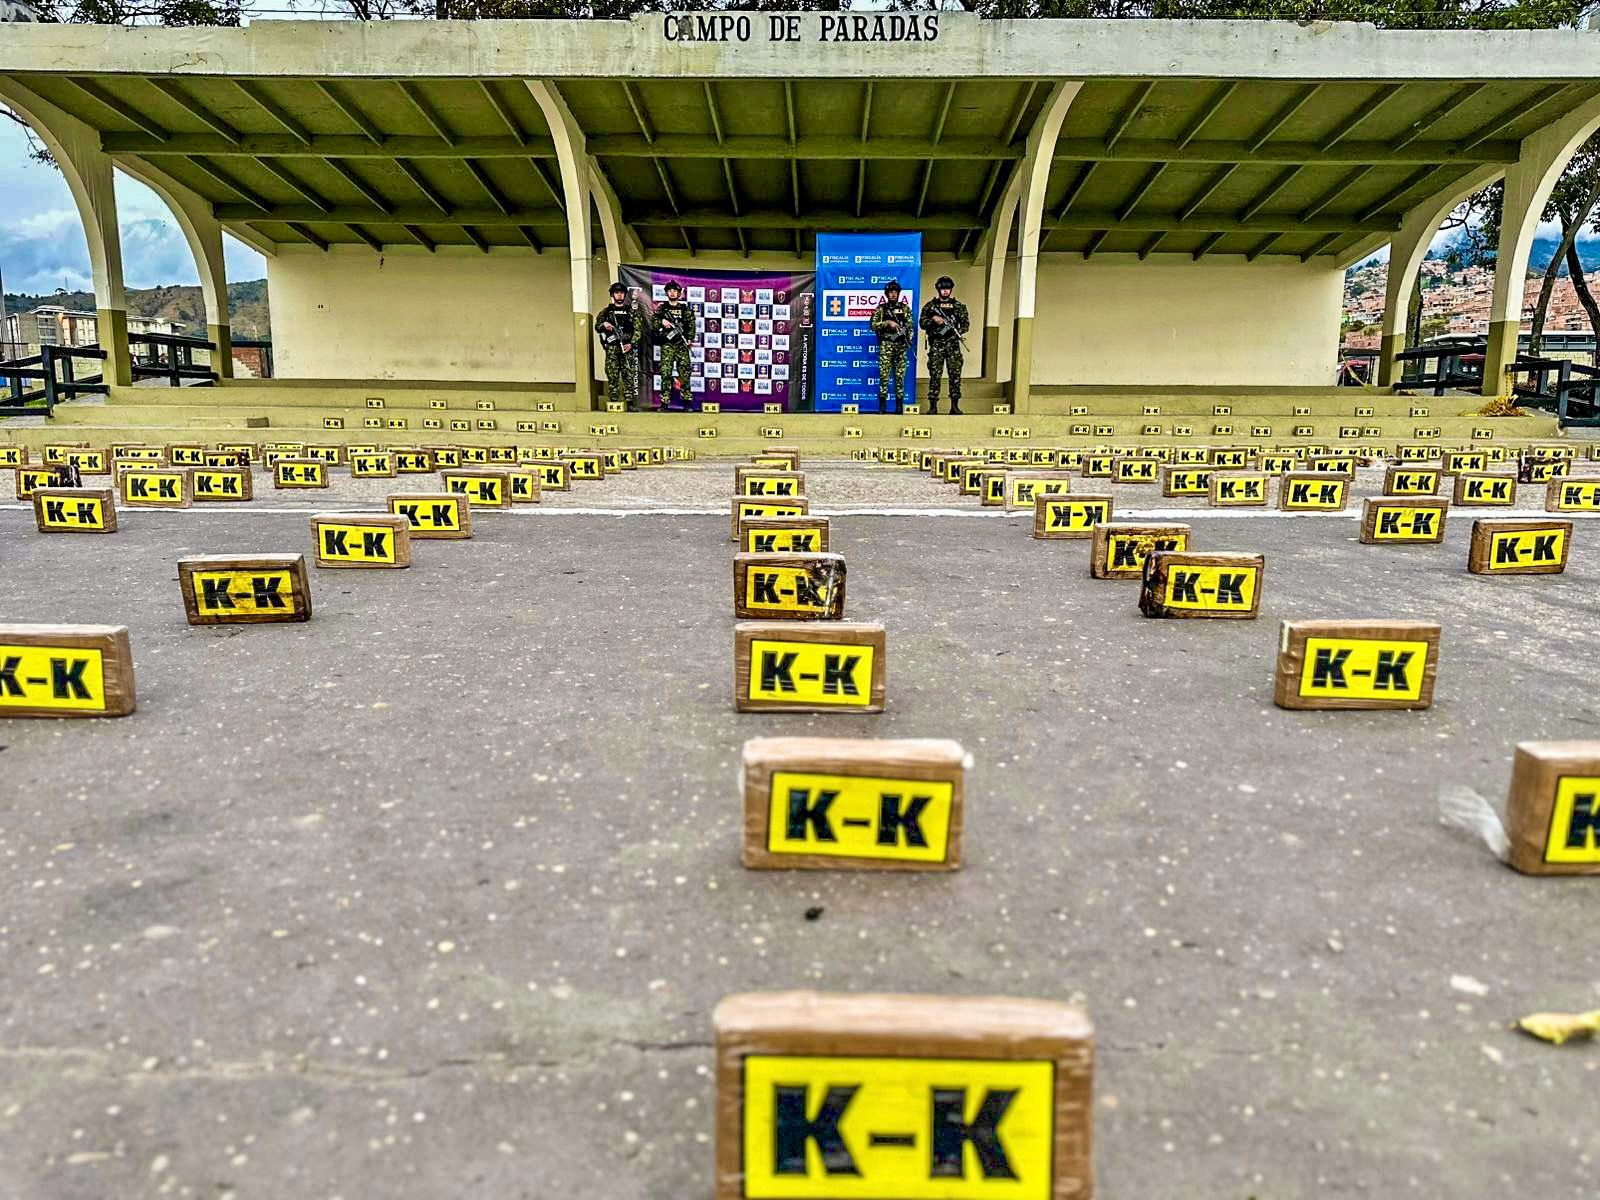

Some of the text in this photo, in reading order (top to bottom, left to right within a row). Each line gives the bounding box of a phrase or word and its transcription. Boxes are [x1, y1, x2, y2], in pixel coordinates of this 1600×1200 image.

[769, 15, 800, 42] DE
[820, 15, 939, 42] PARADAS
[848, 296, 909, 305] FISCAA
[0, 451, 17, 463] -K
[49, 449, 63, 459] K-
[175, 450, 200, 462] K-K
[461, 449, 484, 460] K-K
[491, 450, 512, 459] K-K
[518, 450, 530, 458] -K
[1144, 450, 1166, 459] K-K
[1181, 451, 1204, 461] K-K
[1217, 454, 1242, 464] K-K
[1404, 449, 1425, 458] K-K
[1488, 450, 1500, 460] -K
[70, 456, 99, 468] K-K
[357, 459, 387, 471] K-K
[398, 456, 426, 468] K-K
[1265, 459, 1291, 471] K-K
[1452, 457, 1481, 469] K-K
[282, 467, 317, 481] K-K
[541, 469, 559, 484] -K
[1121, 464, 1153, 477] K-K
[1534, 465, 1564, 479] K-K
[131, 478, 177, 498] K-K
[197, 476, 238, 493] K-K
[749, 482, 792, 496] K-K
[1174, 474, 1208, 489] K-K
[1397, 475, 1430, 490] K-K
[451, 481, 496, 500] K-K
[1220, 481, 1259, 498] K-K
[1292, 484, 1338, 503] K-K
[1468, 481, 1507, 498] K-K
[46, 501, 98, 524] K-K
[399, 504, 453, 526] K-K
[1380, 512, 1435, 535] K-K
[324, 529, 388, 558] K-K
[755, 535, 814, 553] K-K
[1496, 534, 1557, 564] K-K
[201, 577, 286, 610] K-K
[1172, 571, 1246, 604] K-K
[760, 651, 862, 696] K-K
[1311, 648, 1413, 691] K-K
[0, 656, 92, 700] K-K
[785, 787, 935, 848] K-K
[771, 1082, 1023, 1182] K-K
